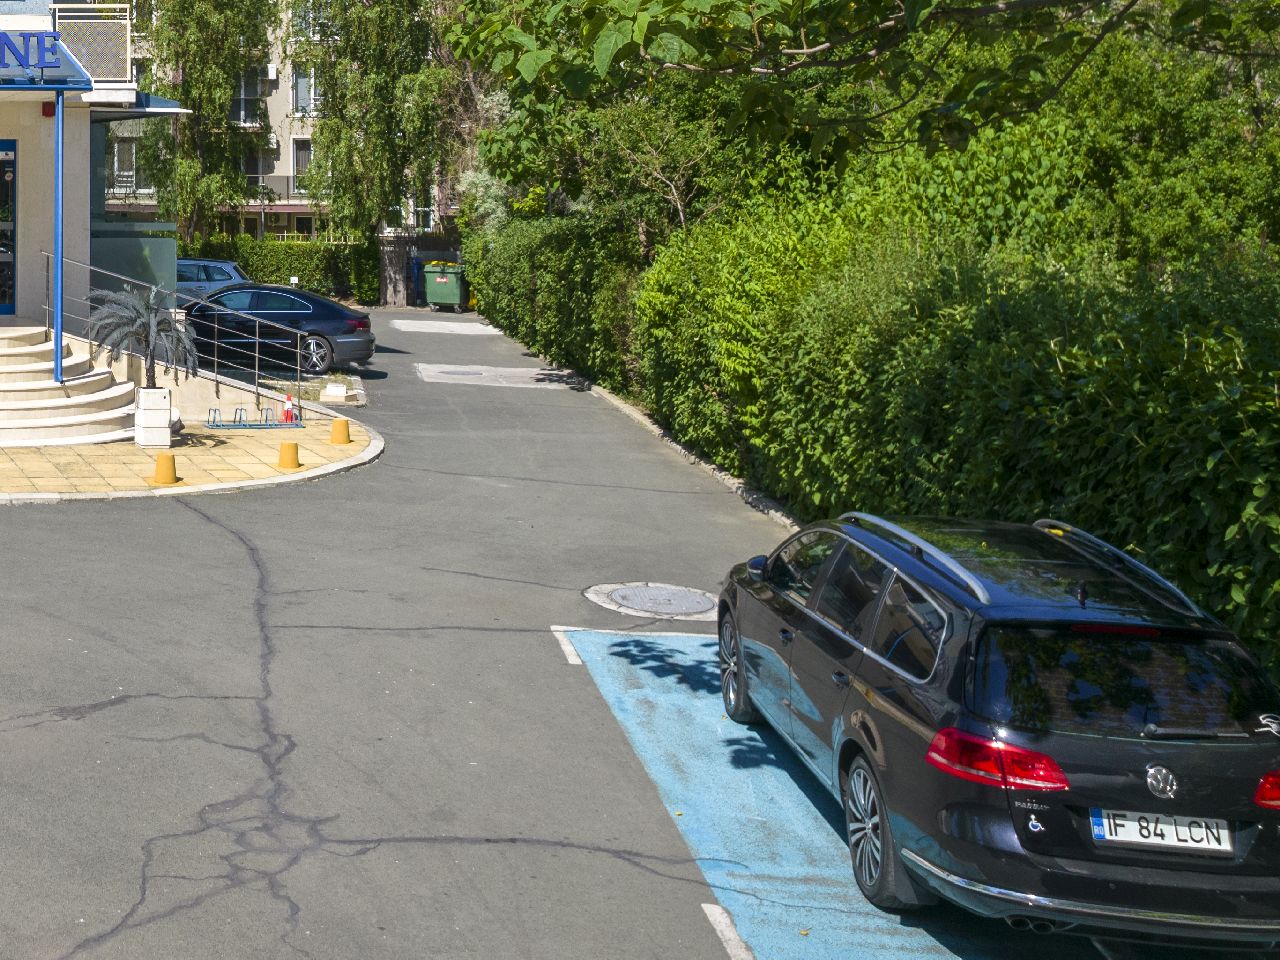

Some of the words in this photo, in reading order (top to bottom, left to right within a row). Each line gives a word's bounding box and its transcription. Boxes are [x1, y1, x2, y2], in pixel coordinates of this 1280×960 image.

[1107, 812, 1127, 837] IF
[1137, 816, 1165, 841] 84
[1173, 818, 1222, 846] LCN
